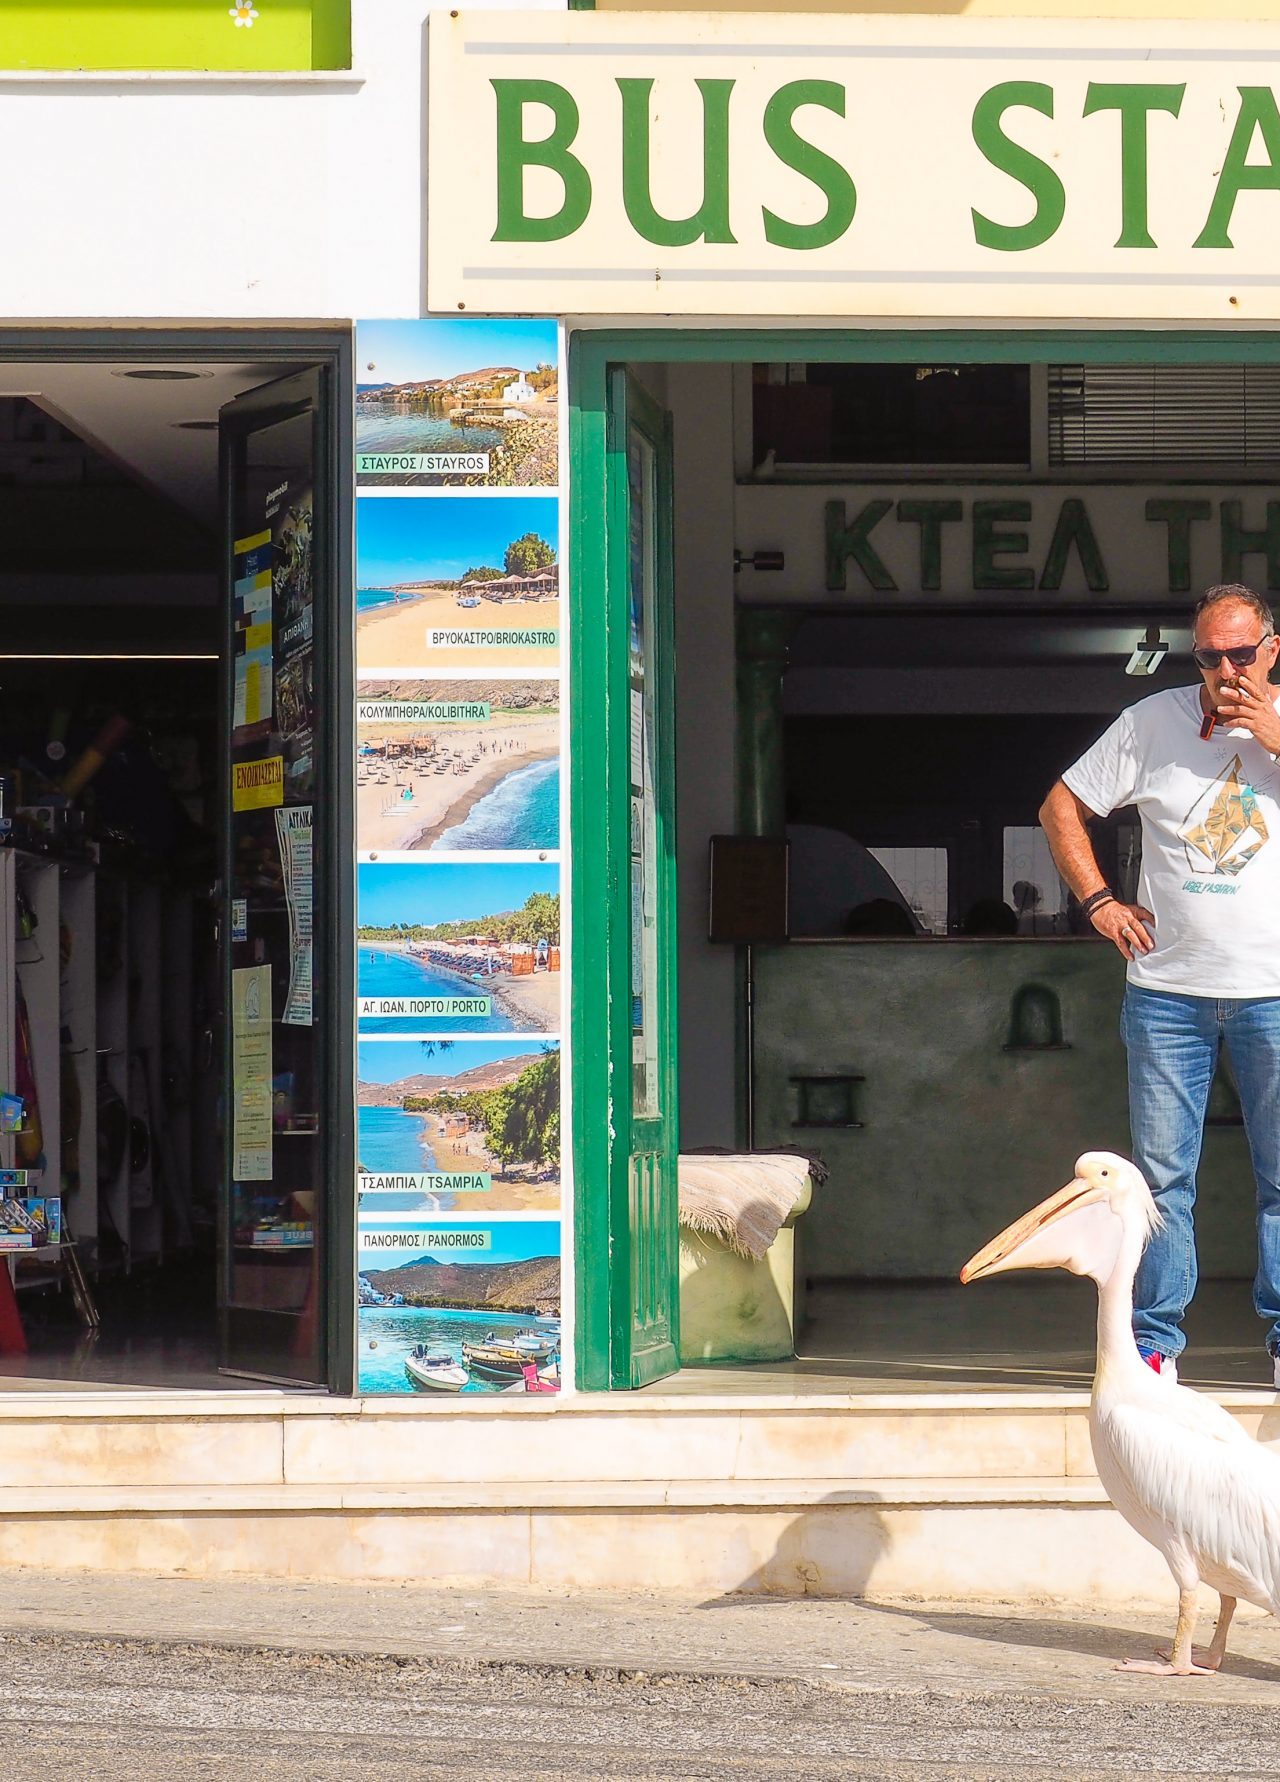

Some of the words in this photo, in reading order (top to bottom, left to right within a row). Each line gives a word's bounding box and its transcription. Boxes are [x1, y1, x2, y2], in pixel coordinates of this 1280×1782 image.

[489, 77, 857, 250] BUS
[361, 456, 417, 470] ΣΤΑΥΡΟΣ
[427, 457, 484, 470] STAYROS
[824, 498, 1110, 592] ΚΤΕΛ
[432, 631, 556, 645] ΒΡΥΟΚΑΣΤΡΟ/BRIOKASTRO
[359, 704, 486, 719] ΚΟΛΥΜΠΗΘΡΑ/KOLIBITHRA
[363, 1001, 378, 1013] ΑΓ.
[380, 1001, 407, 1013] ΙΩΑΝ.
[410, 1001, 444, 1013] ΠΟΡΤΟ
[452, 1000, 487, 1013] PORTO
[361, 1176, 417, 1189] ΤΣΑΜΠΙΑ
[427, 1175, 484, 1189] TSAMPIA
[364, 1234, 420, 1247] ΠΑΝΟΡΜΟΣ
[428, 1233, 485, 1247] PANORMOS
